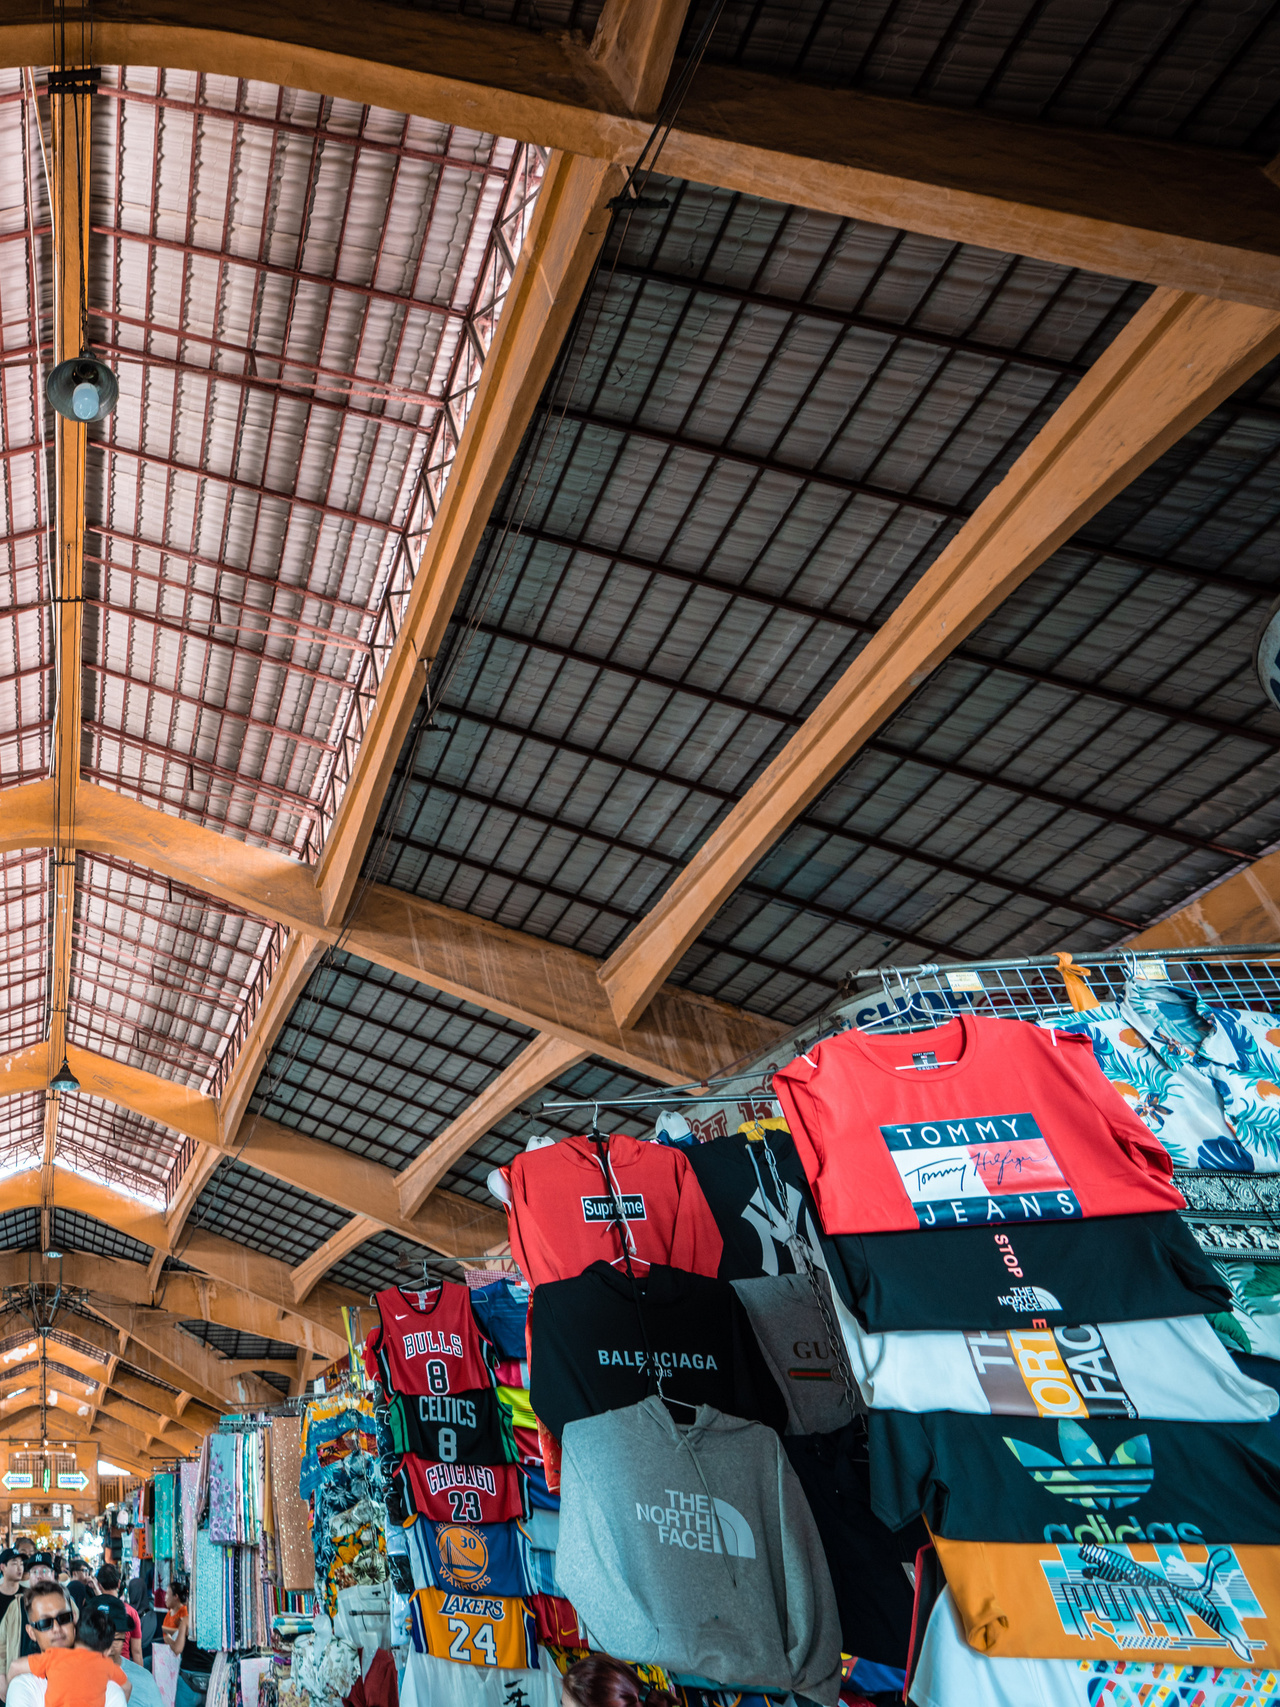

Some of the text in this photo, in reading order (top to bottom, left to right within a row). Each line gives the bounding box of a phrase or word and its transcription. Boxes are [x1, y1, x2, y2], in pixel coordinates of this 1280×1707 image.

[897, 1118, 1019, 1147] TOMMY
[904, 1150, 1048, 1192] Tommy Hilfiger
[924, 1193, 1075, 1226] JEANS
[994, 1234, 1023, 1278] STOP
[997, 1293, 1040, 1306] NORTH
[1010, 1286, 1033, 1297] THE
[1012, 1303, 1043, 1313] FACE
[403, 1331, 463, 1360] BULLS
[426, 1359, 450, 1395] 8
[419, 1395, 477, 1429] CELTICS
[438, 1427, 457, 1463] 8
[426, 1463, 496, 1496] CHICAGO
[448, 1490, 482, 1522] 23
[665, 1489, 710, 1514] THE
[636, 1502, 711, 1533] NORTH
[1043, 1514, 1207, 1544] adidas
[460, 1535, 477, 1550] 30
[658, 1525, 712, 1553] FACE
[438, 1593, 505, 1621] LAKERS
[1061, 1583, 1195, 1640] PUMA
[448, 1617, 498, 1666] 24
